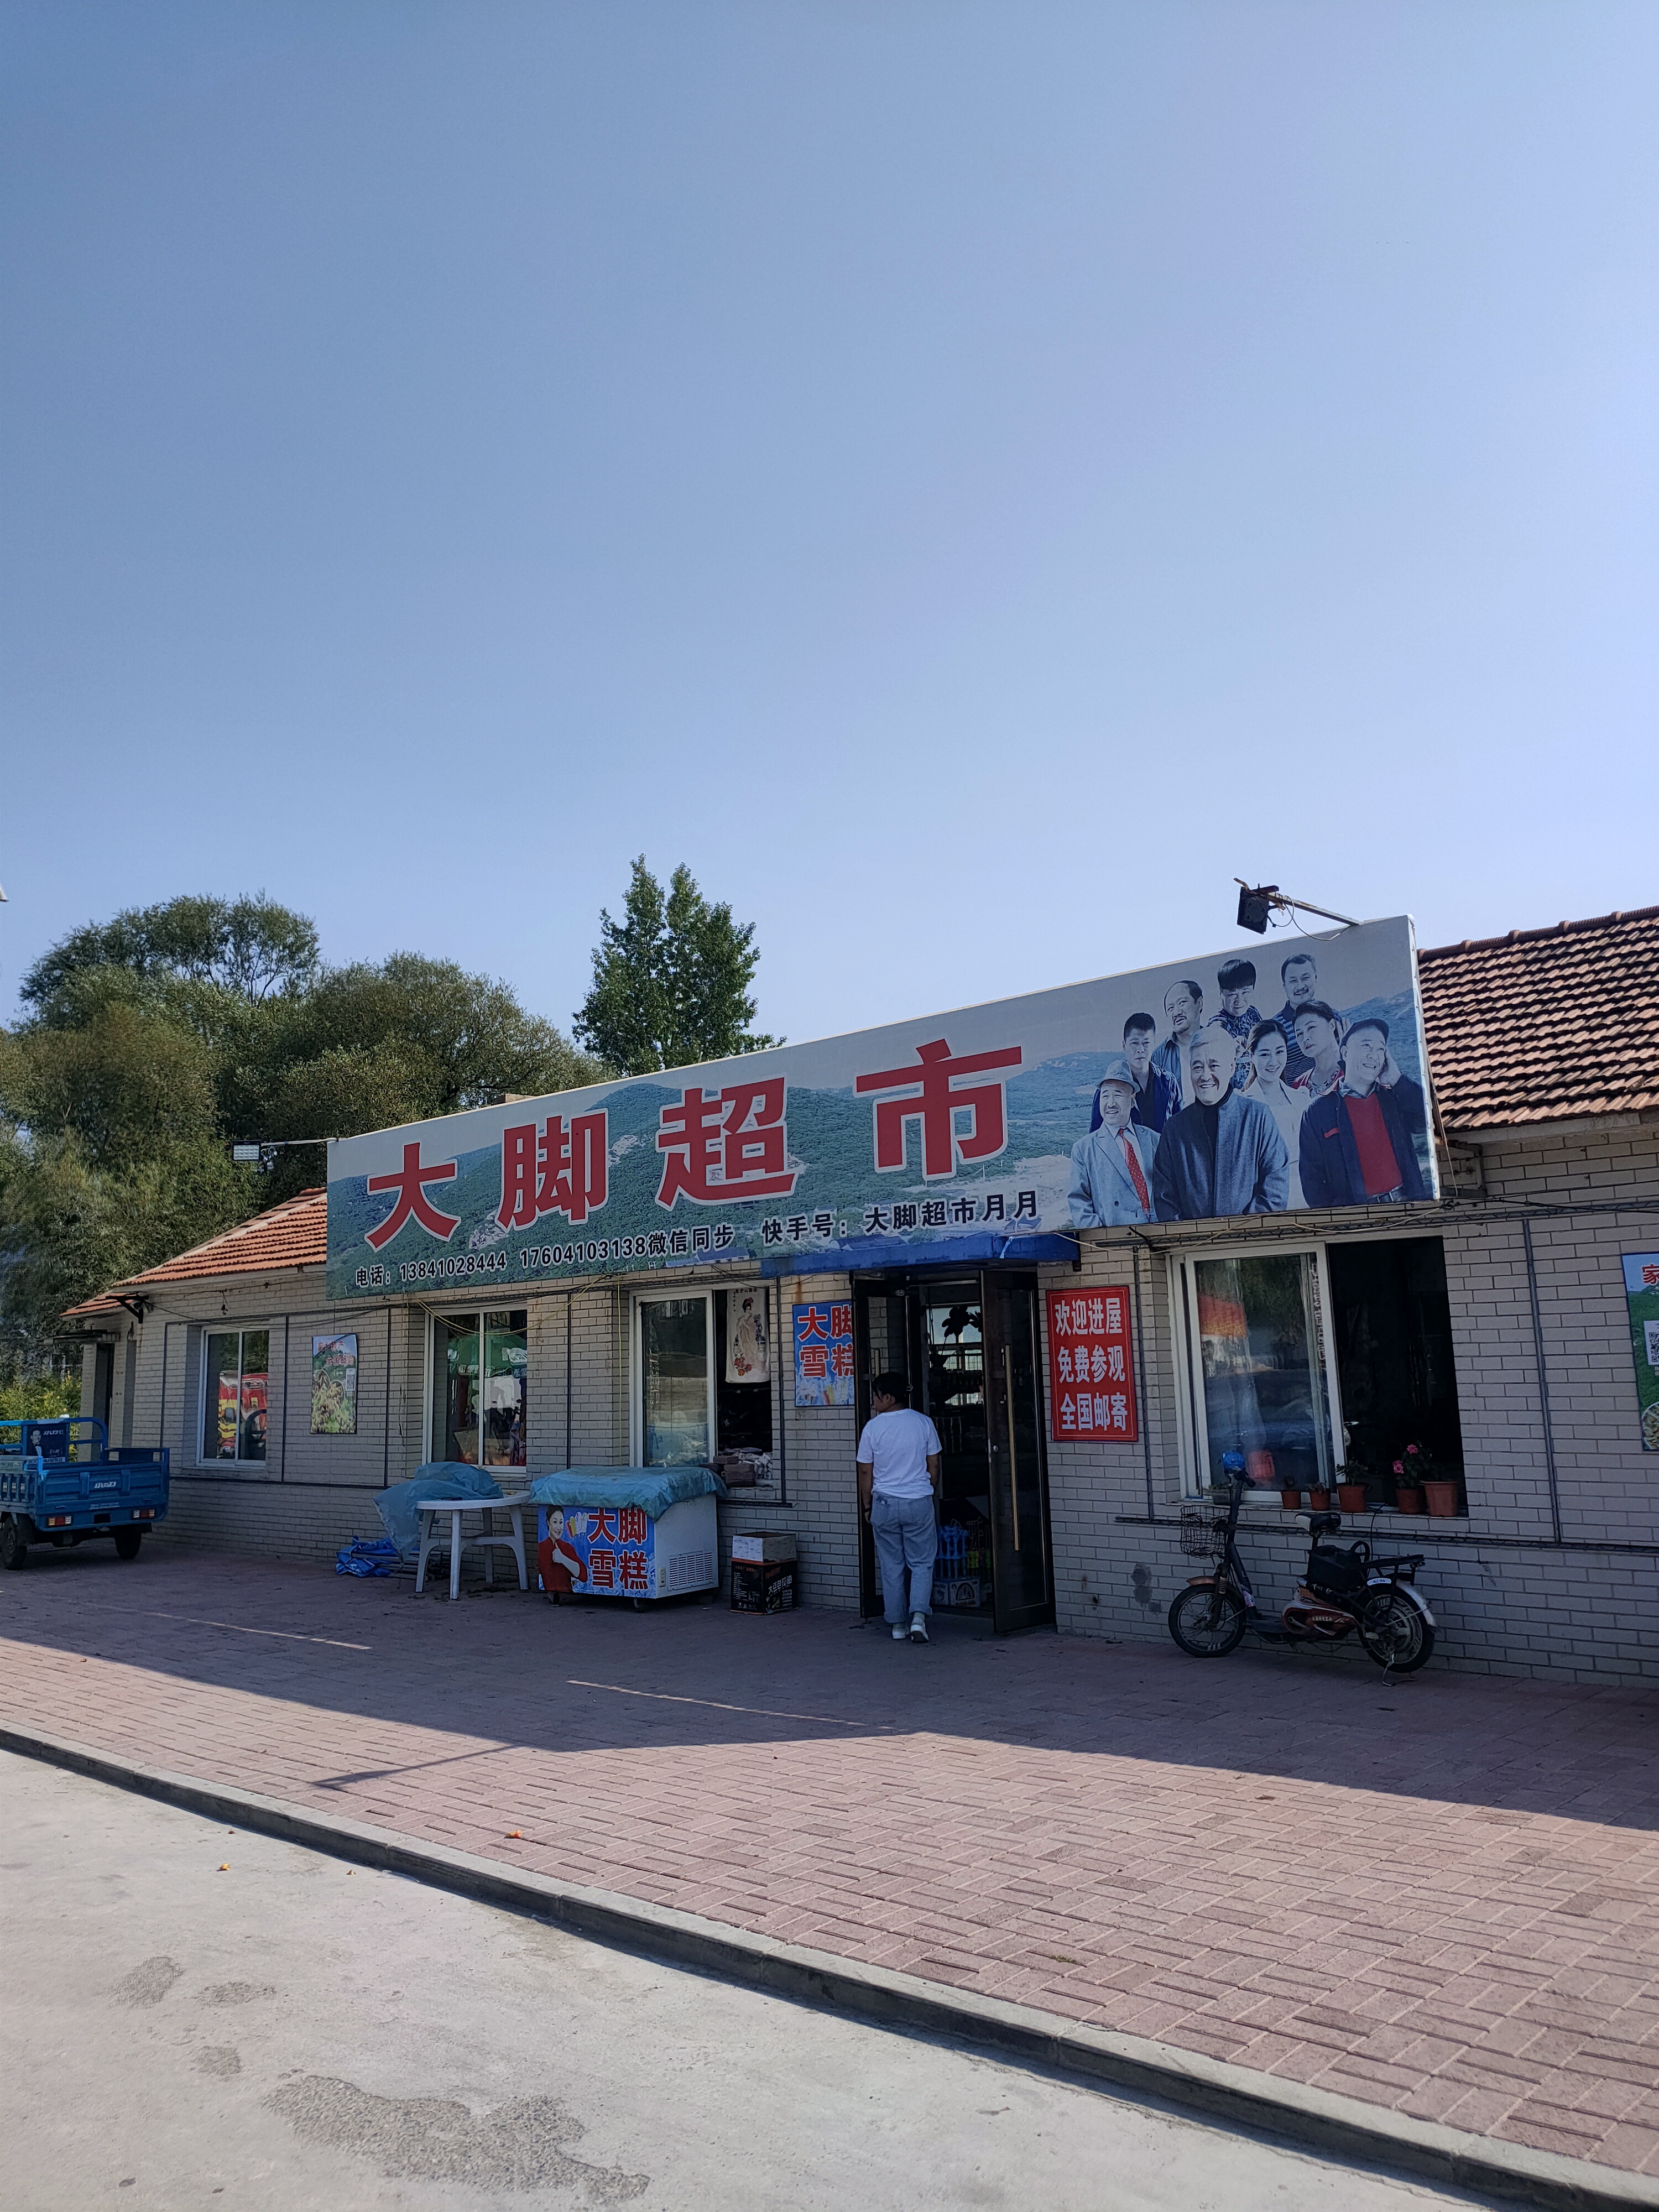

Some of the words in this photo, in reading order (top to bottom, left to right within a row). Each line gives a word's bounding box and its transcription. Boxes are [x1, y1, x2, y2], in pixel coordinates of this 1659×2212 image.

[364, 1037, 1022, 1250] 大脚超市
[520, 1223, 734, 1267] 17604103138微信同步
[1642, 1264, 1659, 1285] 家
[798, 1306, 852, 1341] 大脚
[1055, 1297, 1123, 1337] 欢迎进屋
[800, 1344, 854, 1378] 雪糕
[1057, 1344, 1125, 1384] 免费参观
[1060, 1392, 1128, 1431] 全国邮寄
[587, 1508, 647, 1545] 大脚
[589, 1549, 649, 1590] 雪糕
[768, 1574, 792, 1595] 大豆色拉油
